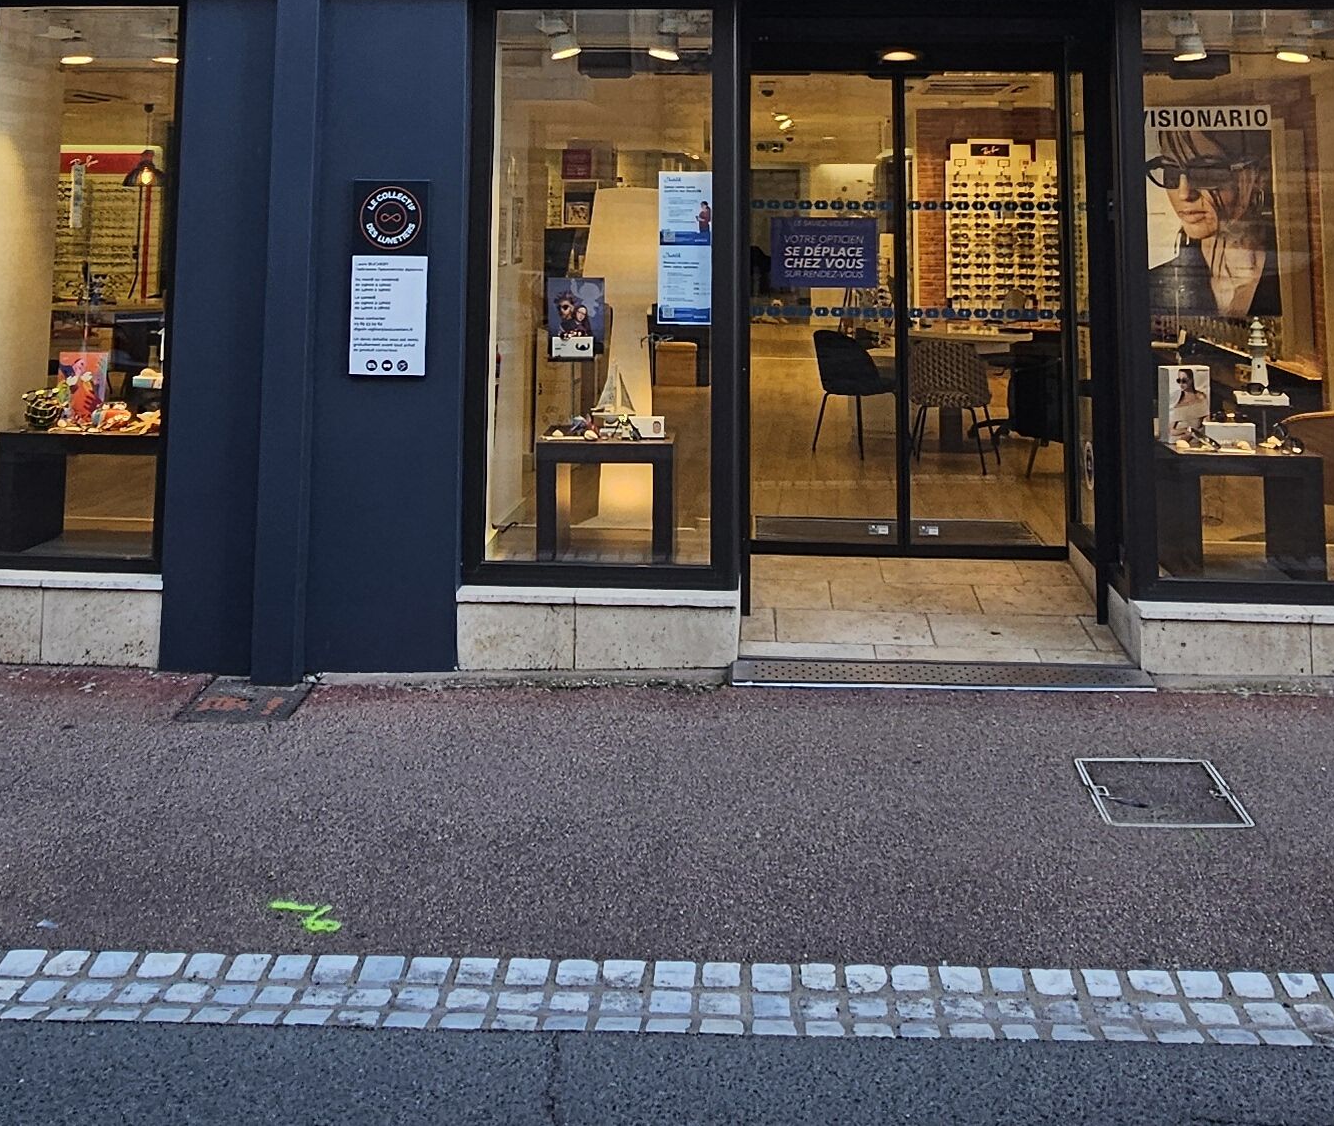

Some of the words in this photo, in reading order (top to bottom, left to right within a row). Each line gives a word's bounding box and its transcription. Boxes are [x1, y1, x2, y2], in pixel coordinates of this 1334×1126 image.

[367, 199, 378, 211] LE
[376, 191, 416, 211] COLLECTIF
[366, 222, 378, 238] DES
[784, 234, 816, 244] VOTRE
[818, 234, 865, 244] OPTICIEN
[784, 246, 801, 257] SE
[804, 243, 864, 257] DÉPLACE
[784, 257, 821, 269] CHEZ
[825, 257, 864, 269] VOUS
[784, 270, 802, 278] SUR
[802, 270, 864, 279] RENDEZ-VOUS
